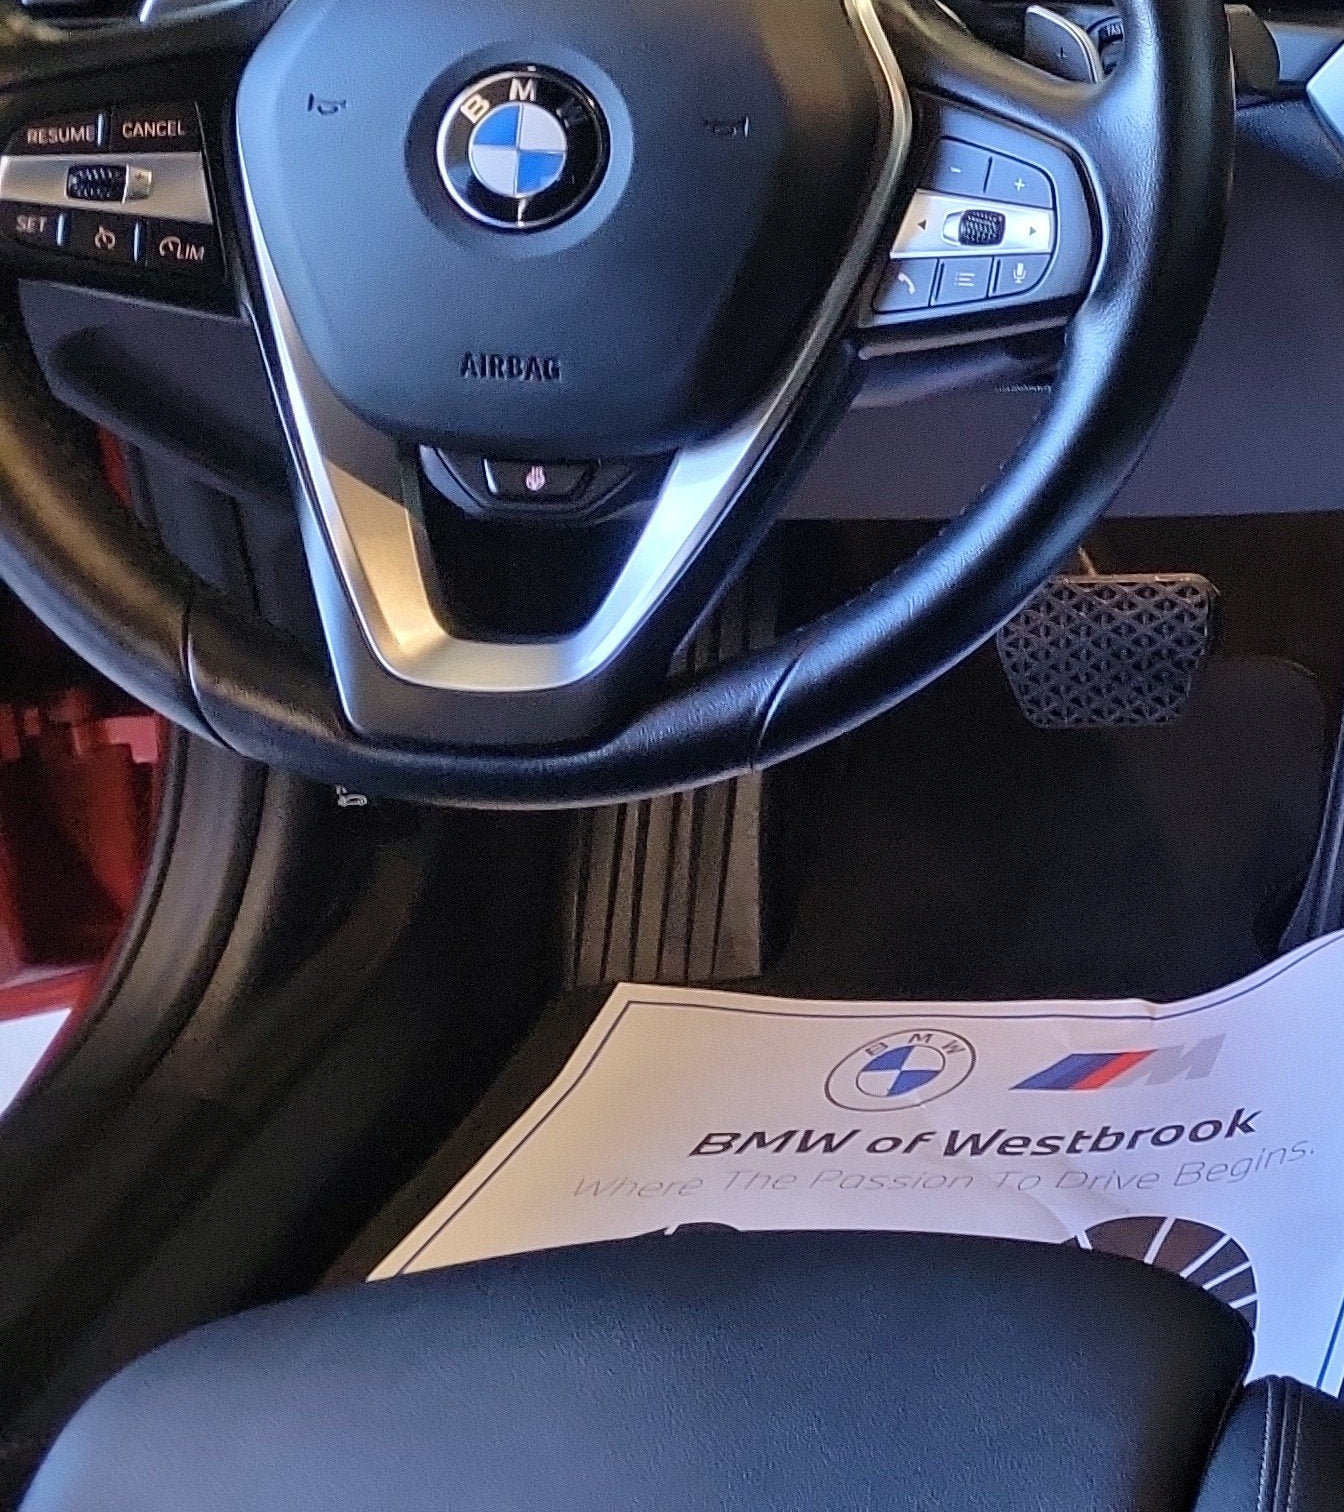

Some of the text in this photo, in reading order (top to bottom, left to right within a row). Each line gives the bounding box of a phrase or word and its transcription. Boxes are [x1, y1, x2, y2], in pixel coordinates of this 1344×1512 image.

[27, 123, 98, 144] RESUME
[121, 119, 185, 139] CANCEL
[15, 214, 48, 233] SET
[459, 351, 562, 382] AIRBAG
[864, 1032, 968, 1057] BMW
[687, 1106, 1263, 1159] BMW of Westbrook
[573, 1137, 1317, 1201] Where The Passion To Drive Begins.
